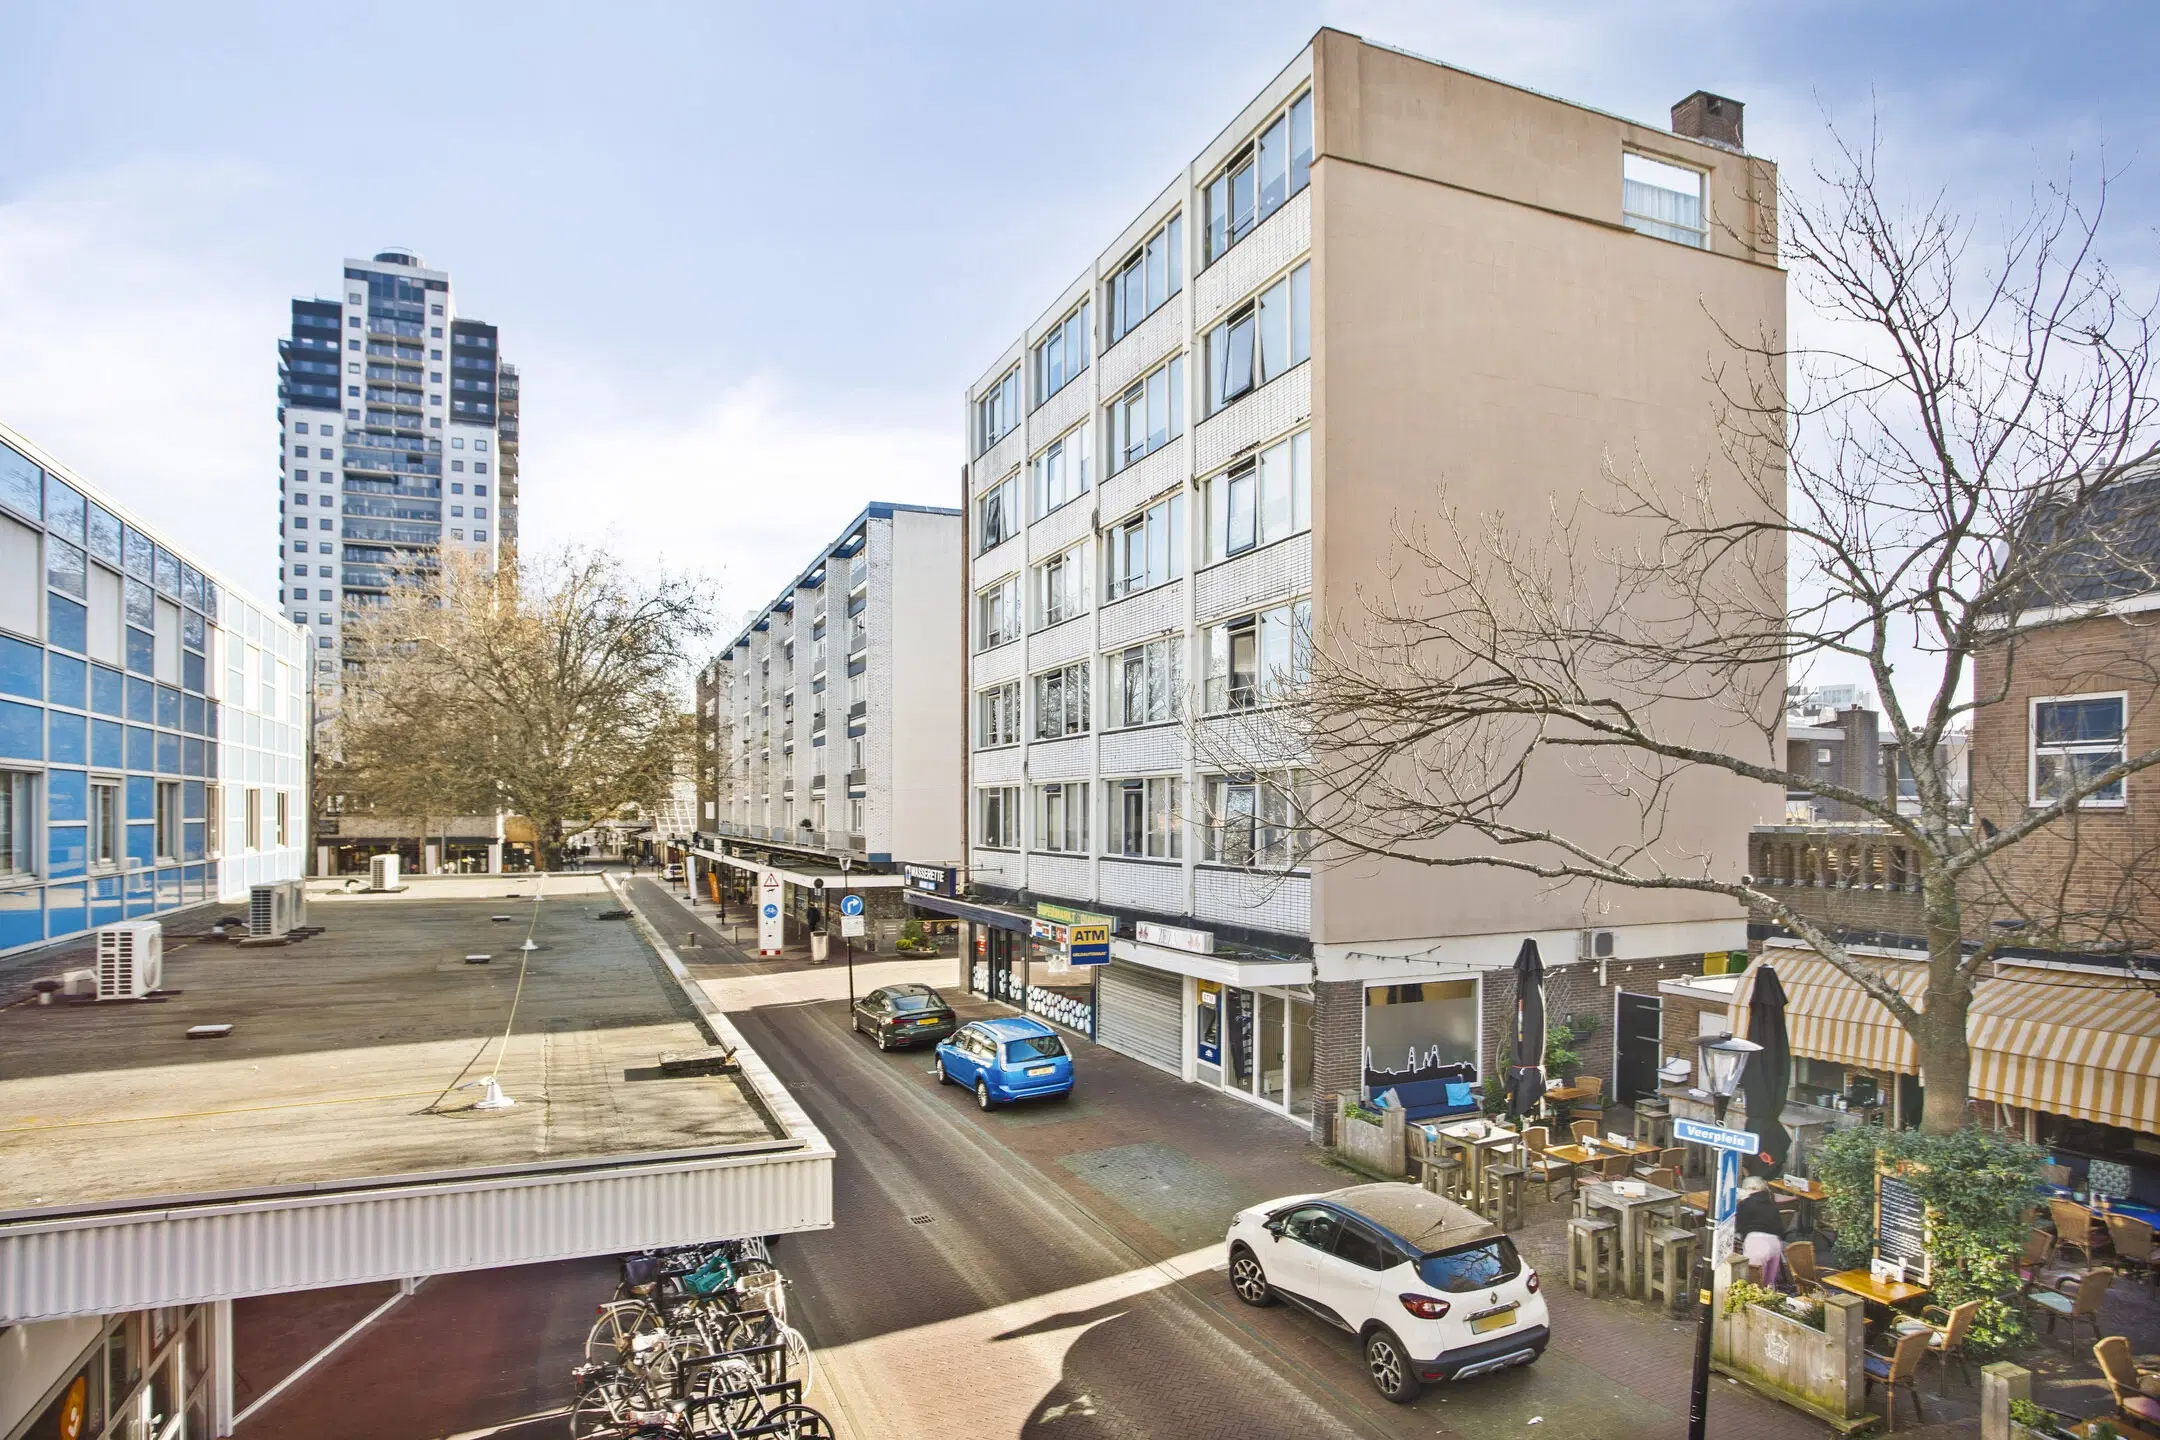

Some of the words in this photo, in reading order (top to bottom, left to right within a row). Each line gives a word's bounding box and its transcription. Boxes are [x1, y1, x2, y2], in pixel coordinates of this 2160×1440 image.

[911, 866, 945, 882] WASSERETTE
[1074, 930, 1105, 942] ATM
[1687, 1125, 1745, 1146] Veerplein
